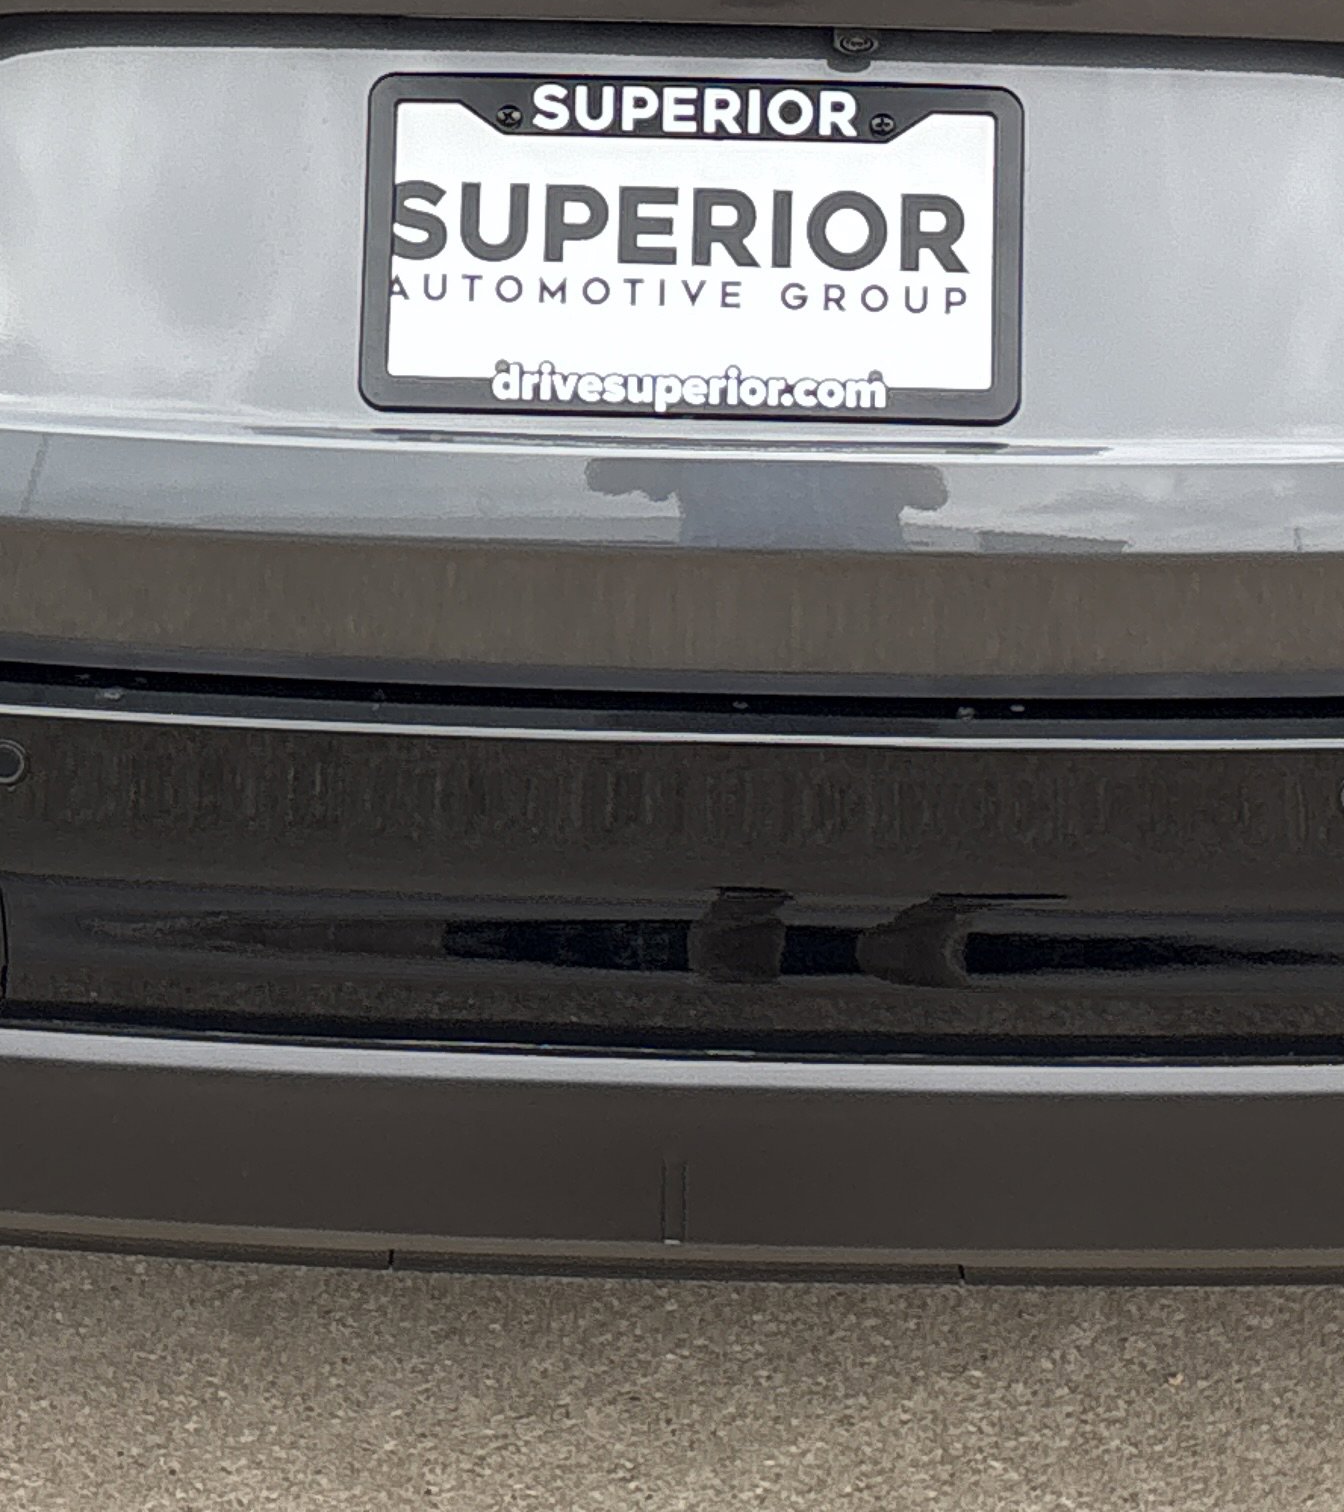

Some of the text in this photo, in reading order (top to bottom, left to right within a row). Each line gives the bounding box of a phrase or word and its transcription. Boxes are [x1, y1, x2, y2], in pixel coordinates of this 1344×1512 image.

[531, 84, 858, 138] SUPERIOR
[392, 180, 970, 274] SUPERIOR
[389, 273, 968, 315] AUTOMOTIVE GROUP
[492, 361, 887, 412] drivesuperior.com
